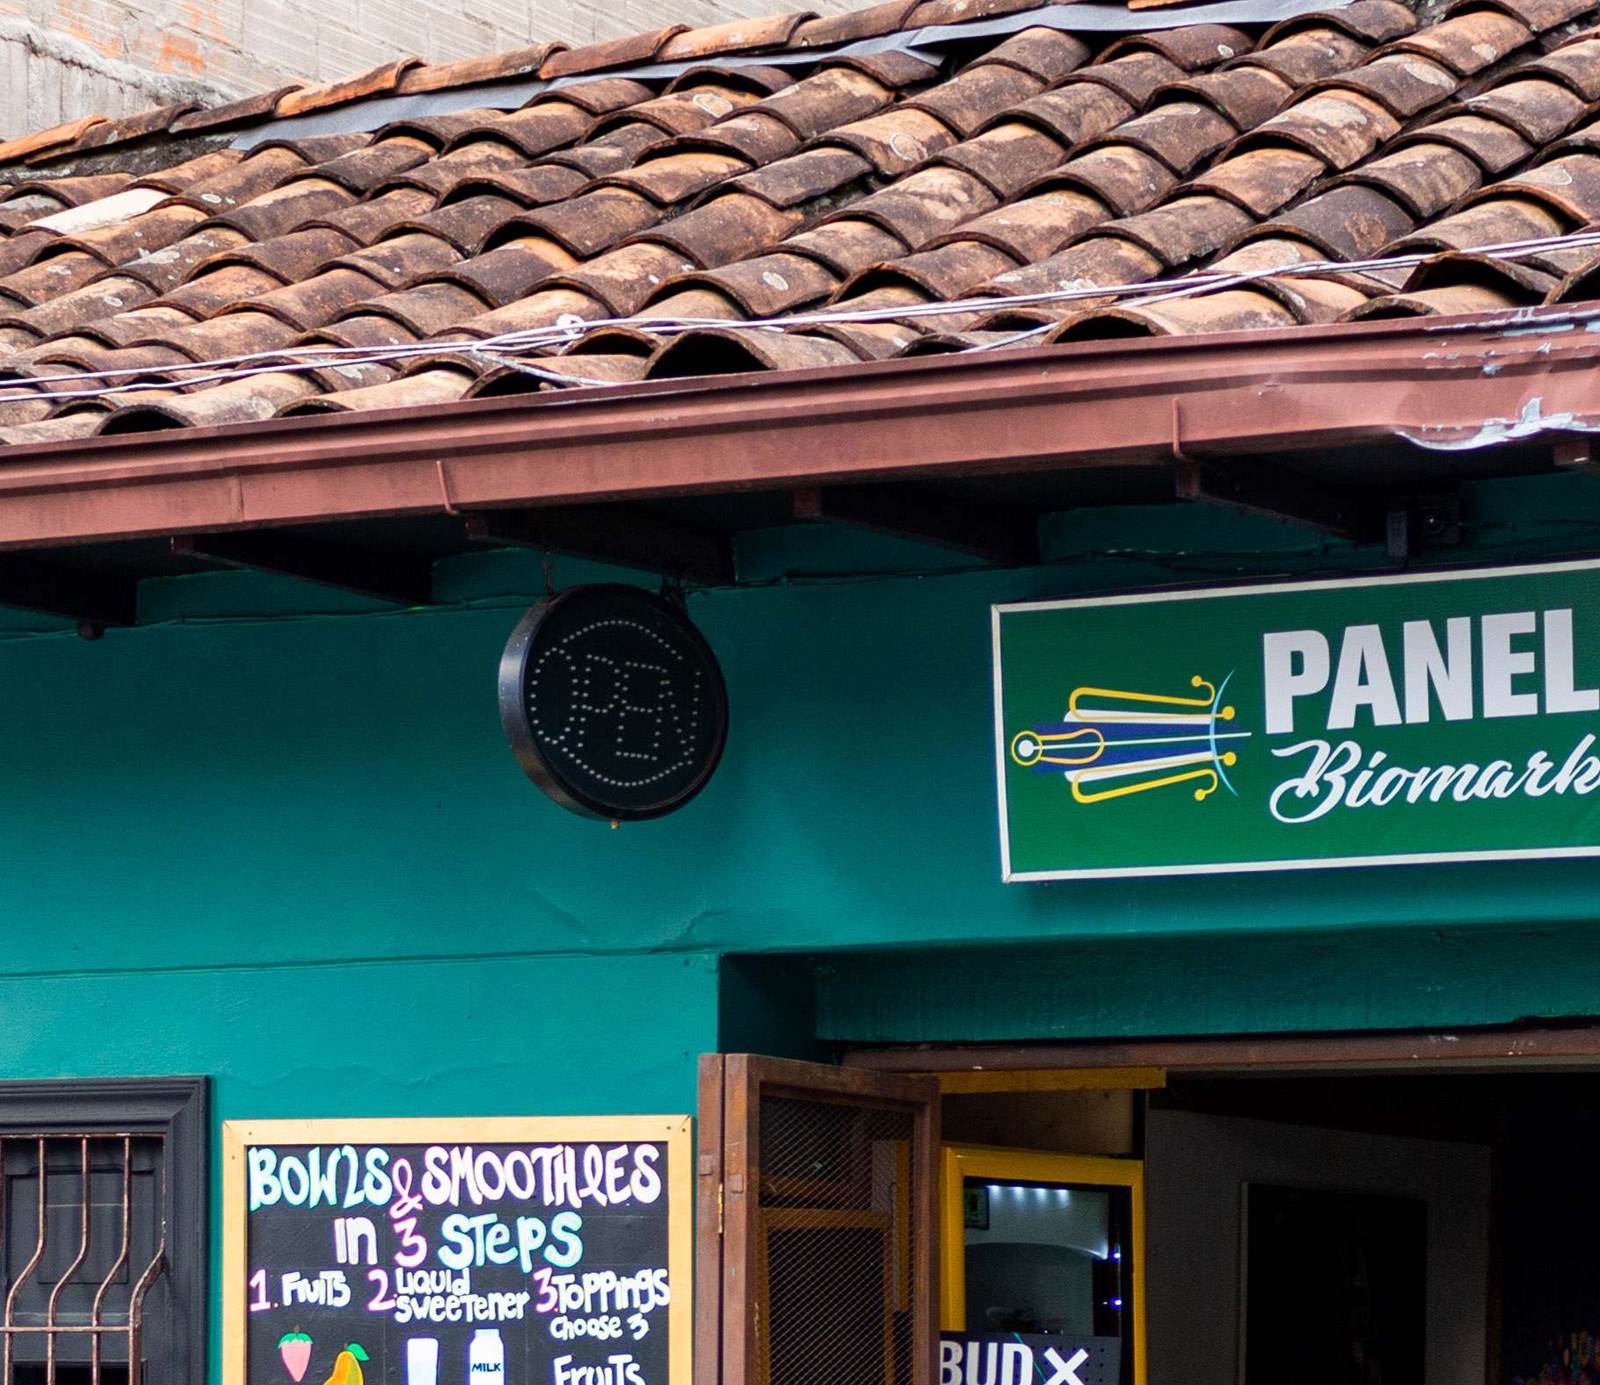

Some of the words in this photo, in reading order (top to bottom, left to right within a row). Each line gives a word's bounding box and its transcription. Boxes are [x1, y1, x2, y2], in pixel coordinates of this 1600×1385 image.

[1264, 608, 1600, 734] PANEL
[1270, 733, 1600, 823] Biomark
[249, 1145, 393, 1211] BOWLS
[389, 1158, 424, 1219] &
[421, 1145, 662, 1208] SMOOTHIES
[394, 1218, 428, 1268] 3
[627, 1313, 650, 1341] 3
[471, 1362, 502, 1373] MILK
